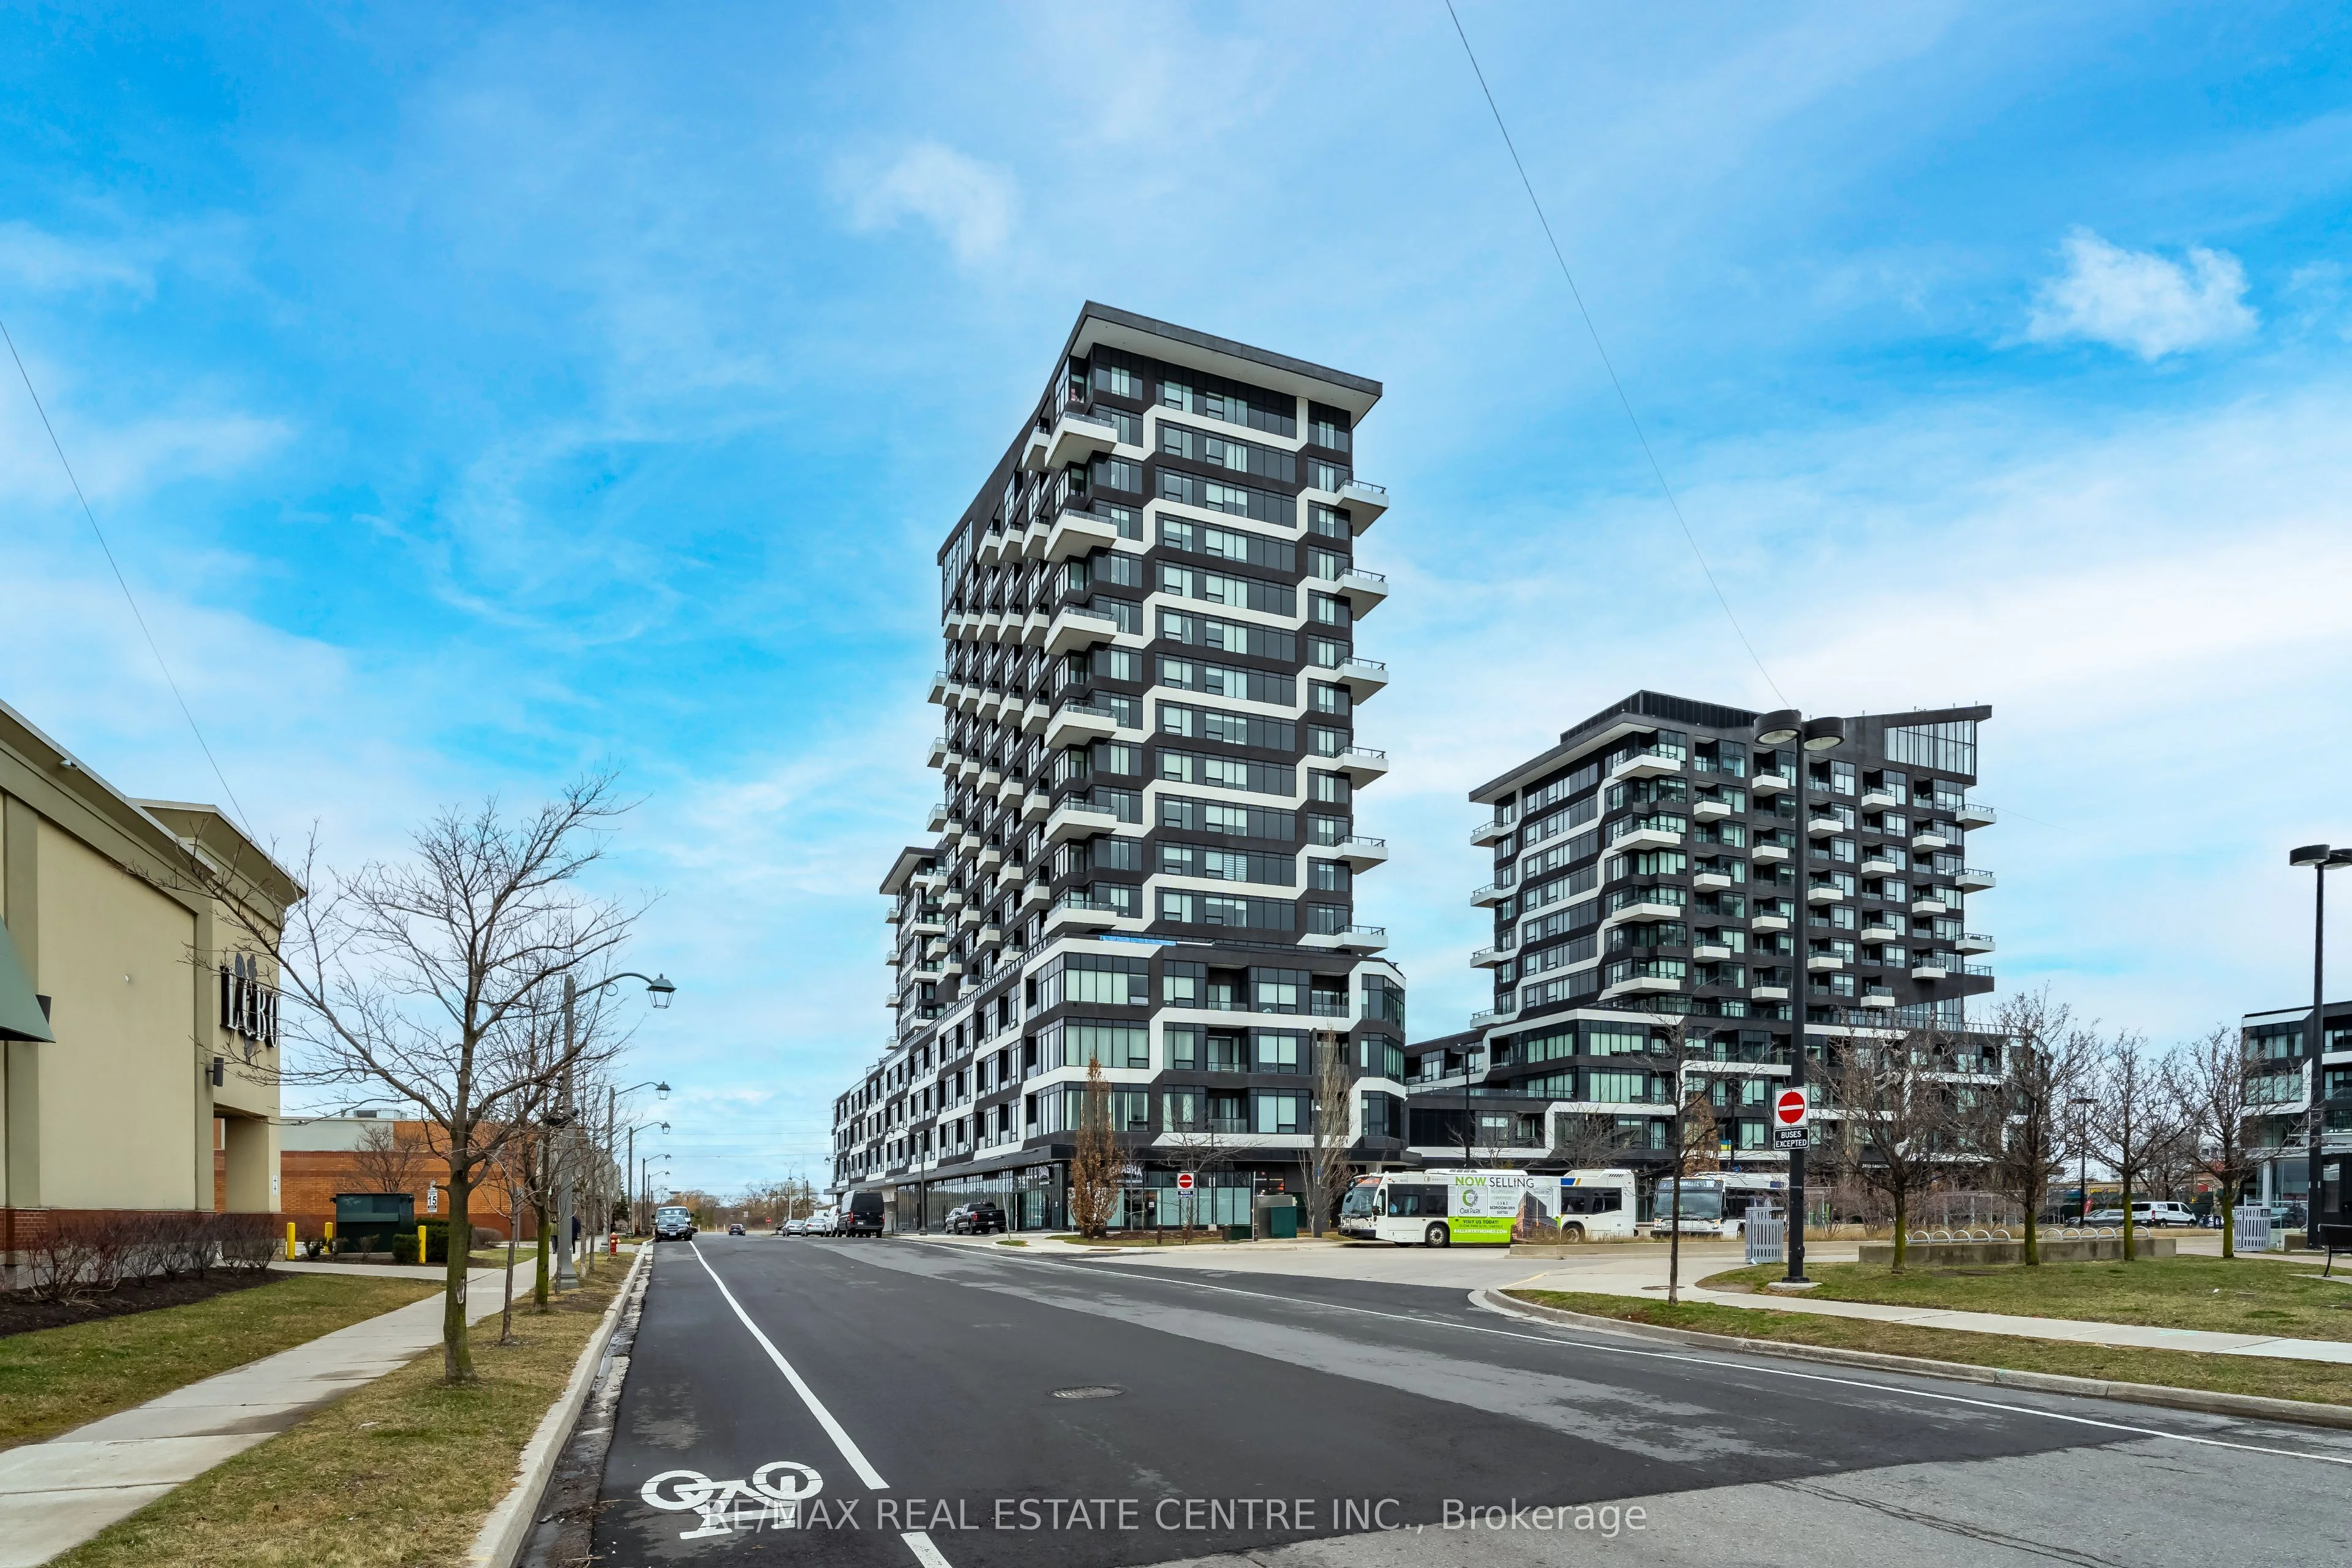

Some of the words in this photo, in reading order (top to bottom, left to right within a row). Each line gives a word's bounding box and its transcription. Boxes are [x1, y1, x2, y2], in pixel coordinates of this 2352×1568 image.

[220, 966, 280, 1048] LCBO
[1455, 1176, 1487, 1186] NOW
[1488, 1177, 1534, 1188] SELLING
[428, 1196, 437, 1205] 15
